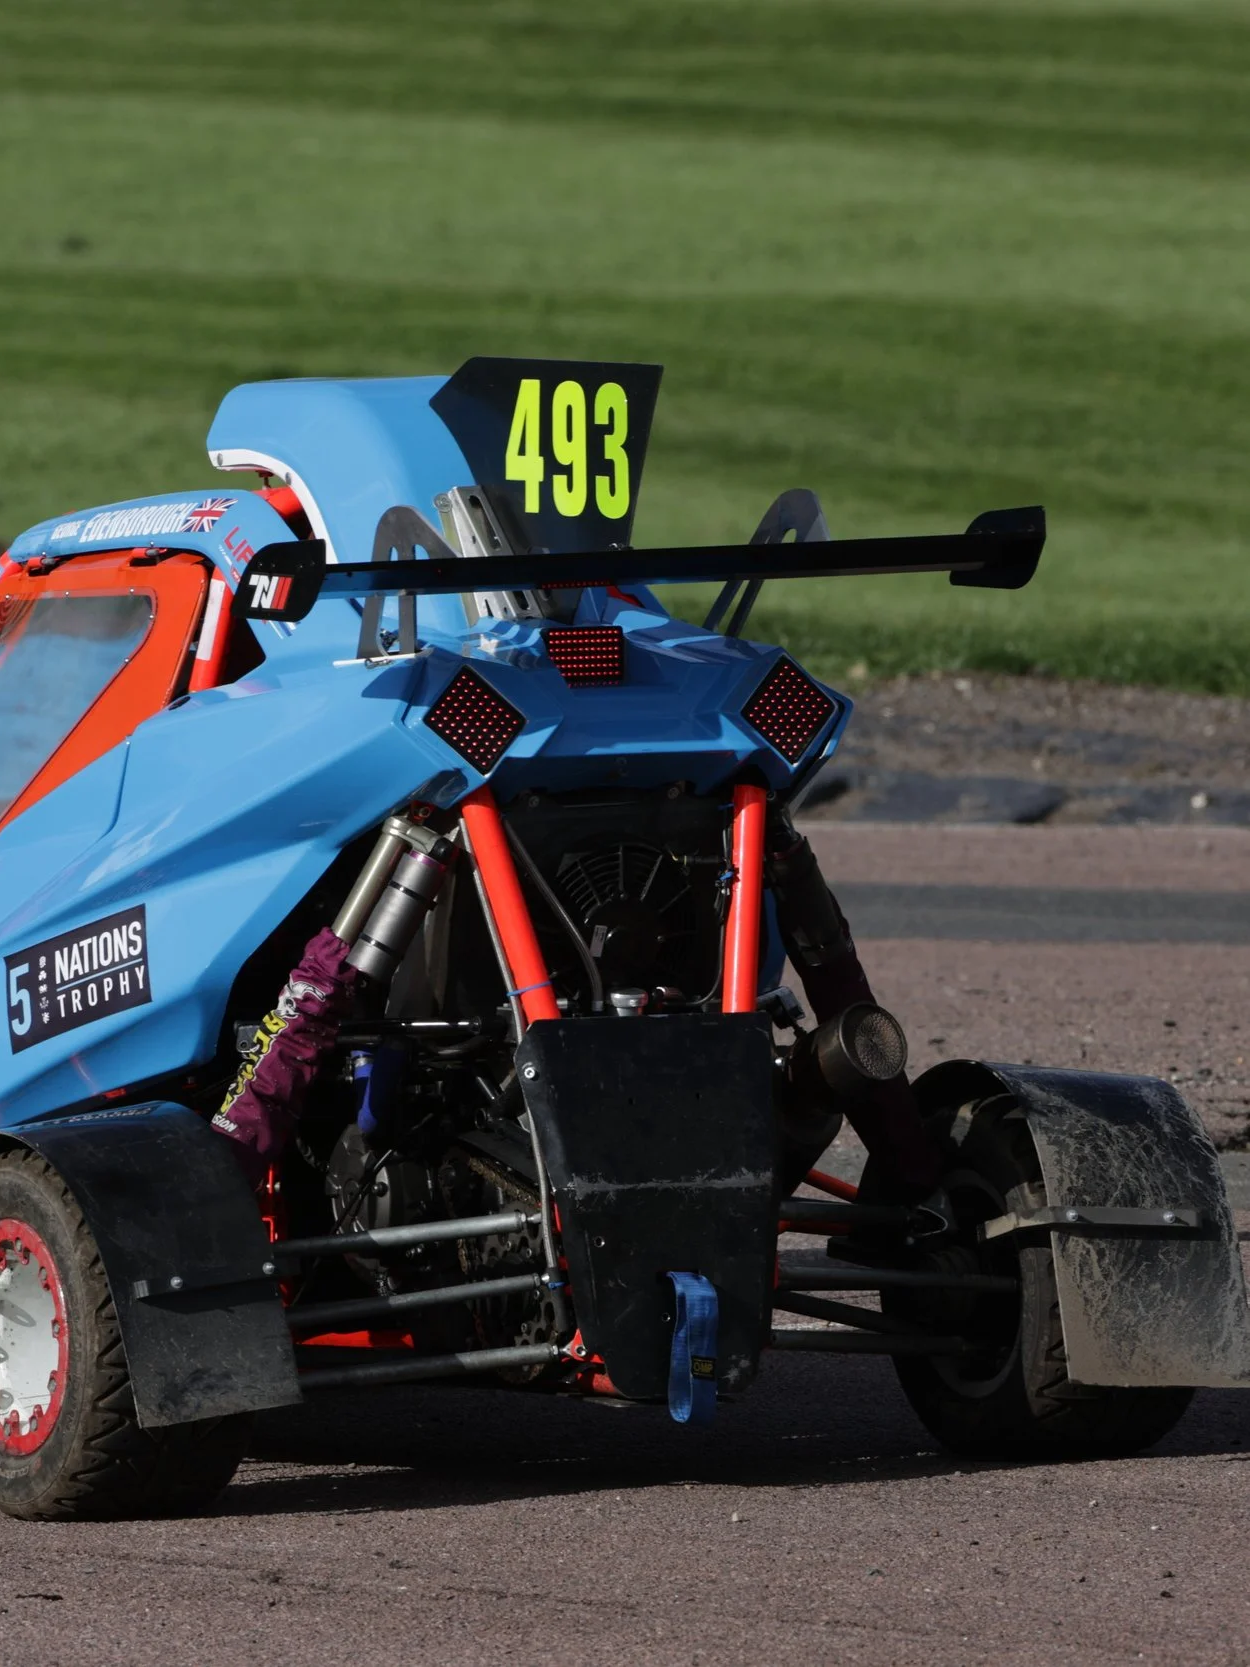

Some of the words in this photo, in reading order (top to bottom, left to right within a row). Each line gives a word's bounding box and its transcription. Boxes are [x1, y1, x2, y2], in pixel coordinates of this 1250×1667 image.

[505, 378, 630, 520] 493
[55, 921, 143, 985] NATIONS
[9, 962, 32, 1036] 5
[56, 965, 145, 1018] TROPHY
